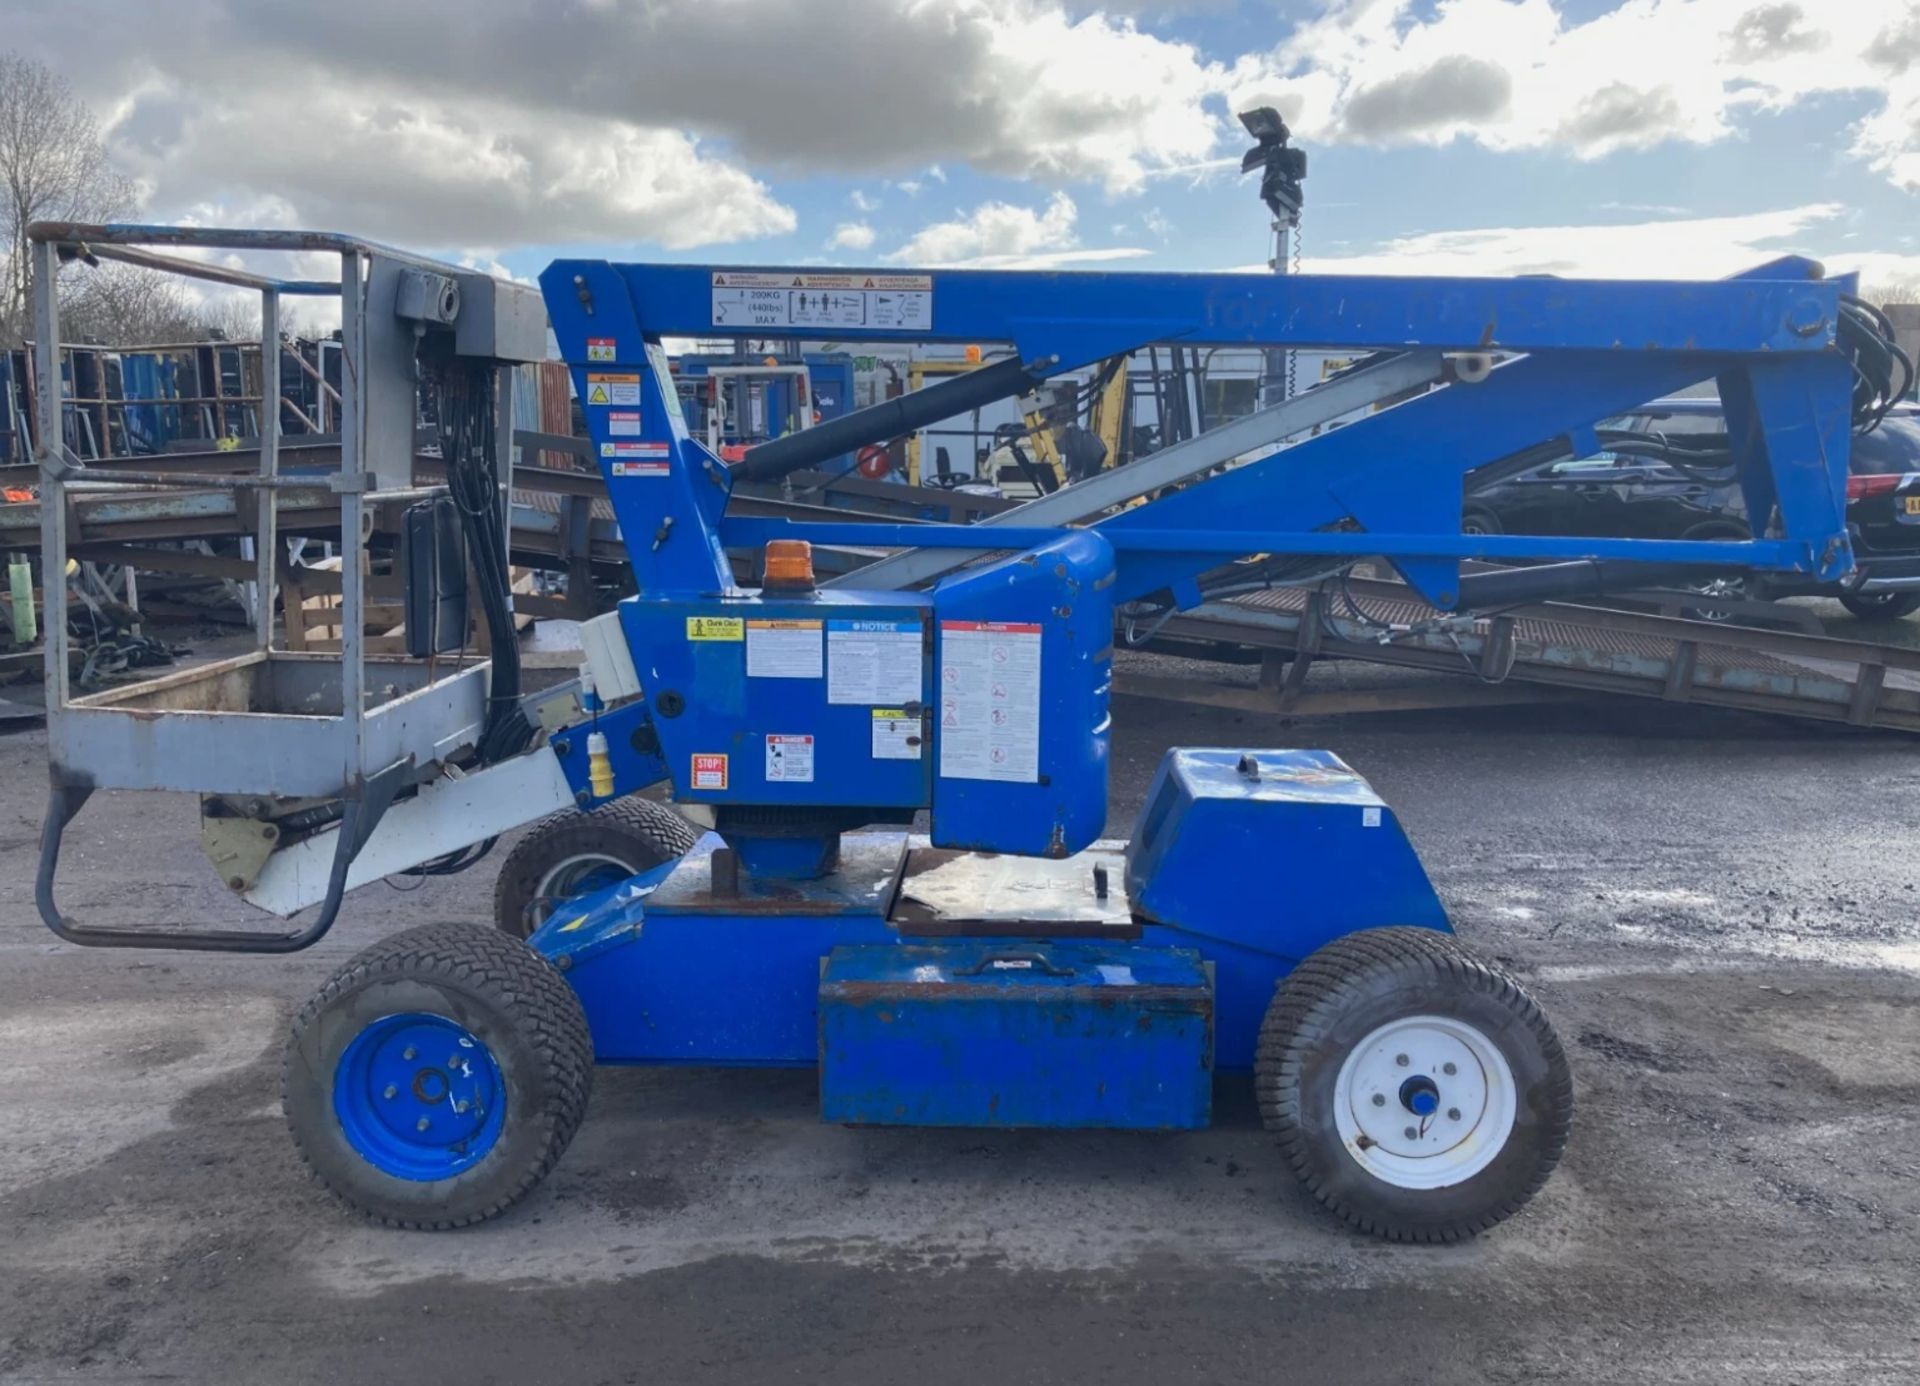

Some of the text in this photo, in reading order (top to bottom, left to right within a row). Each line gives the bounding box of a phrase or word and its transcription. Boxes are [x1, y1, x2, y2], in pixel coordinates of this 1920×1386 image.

[750, 290, 781, 300] 200KG
[748, 303, 783, 313] (440lbs)
[755, 316, 776, 325] MAX
[861, 622, 897, 632] NOTICE
